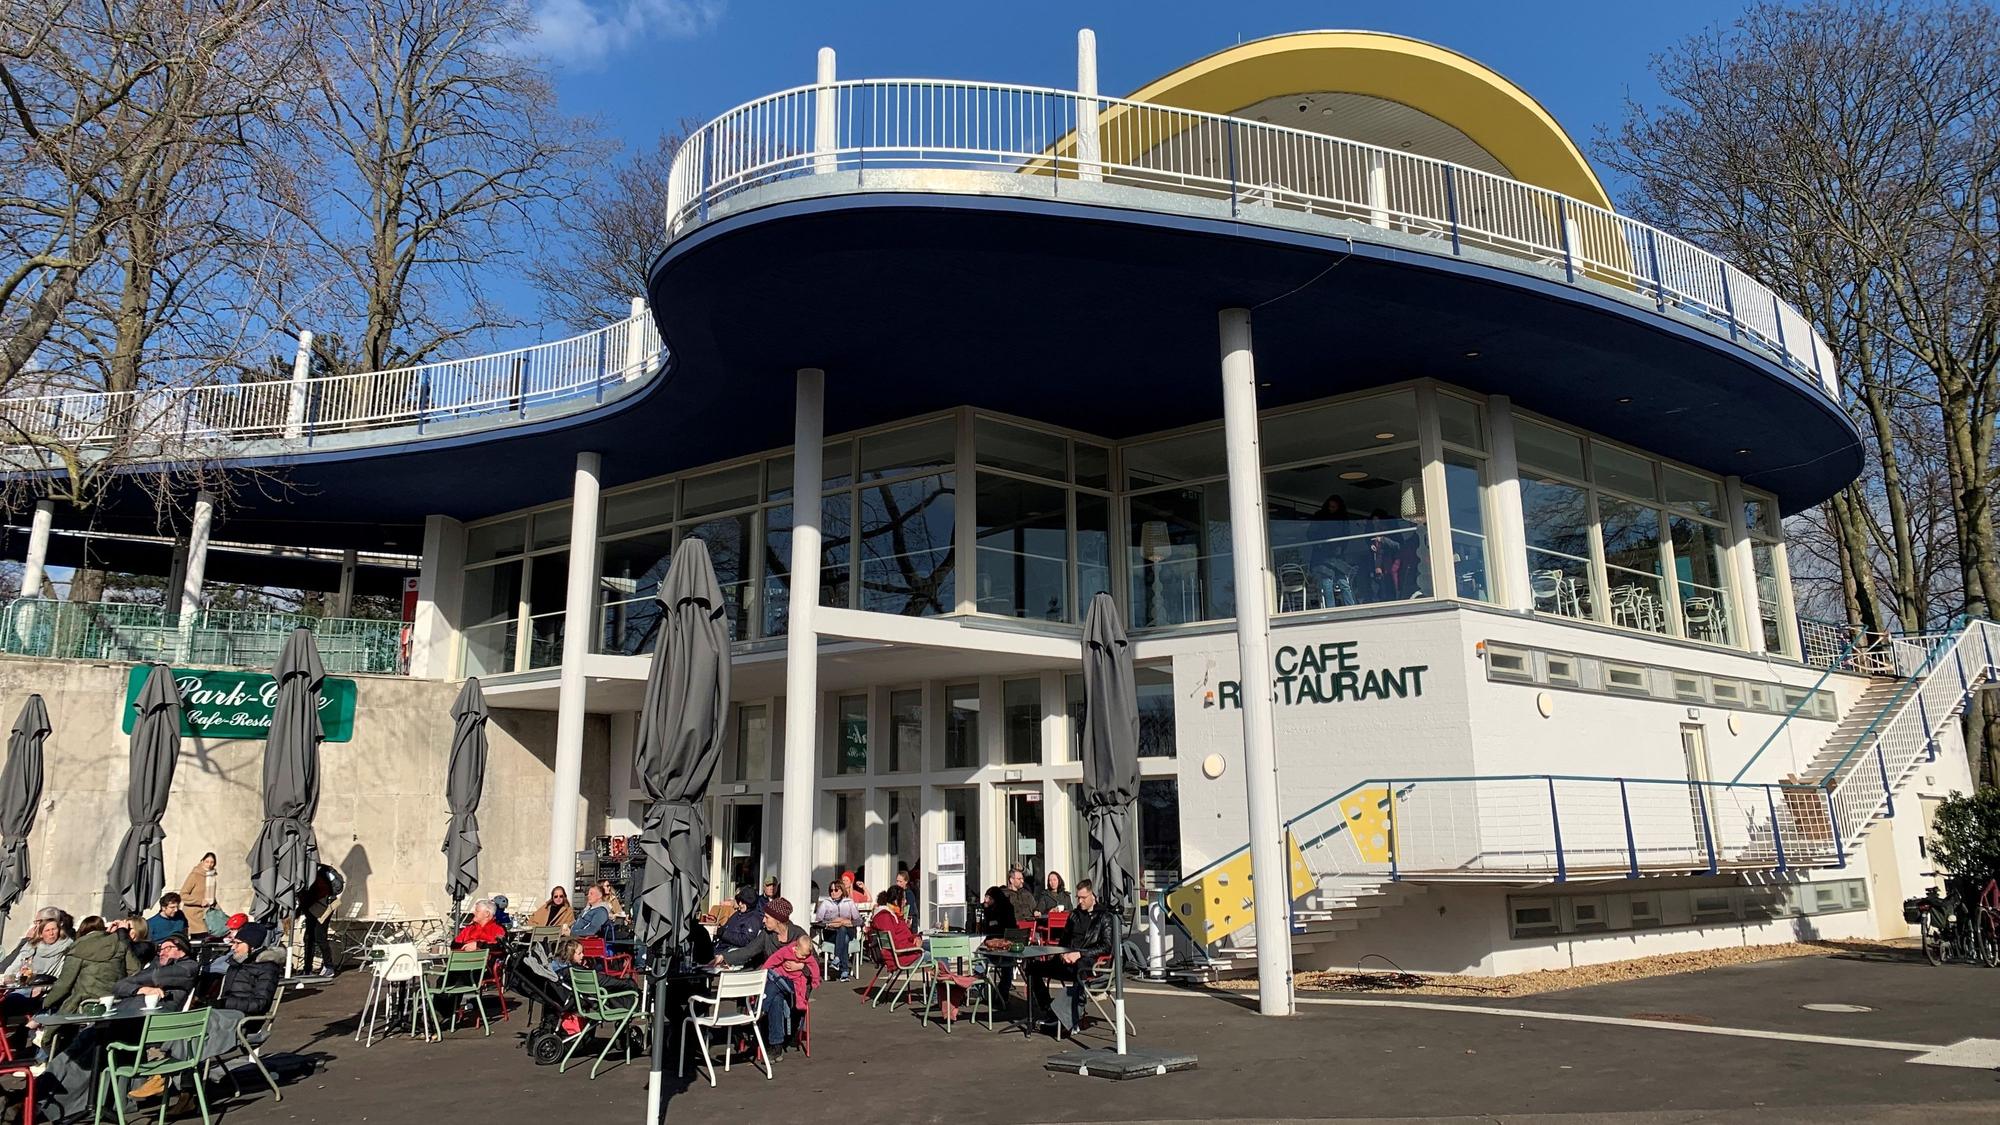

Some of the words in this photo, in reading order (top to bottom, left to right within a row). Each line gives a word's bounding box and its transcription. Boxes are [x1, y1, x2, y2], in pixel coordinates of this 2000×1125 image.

[1275, 641, 1360, 675] CAFE
[174, 675, 334, 710] Park-Ce
[1218, 665, 1428, 710] RTAURANT
[187, 709, 272, 730] Cafe-Resta
